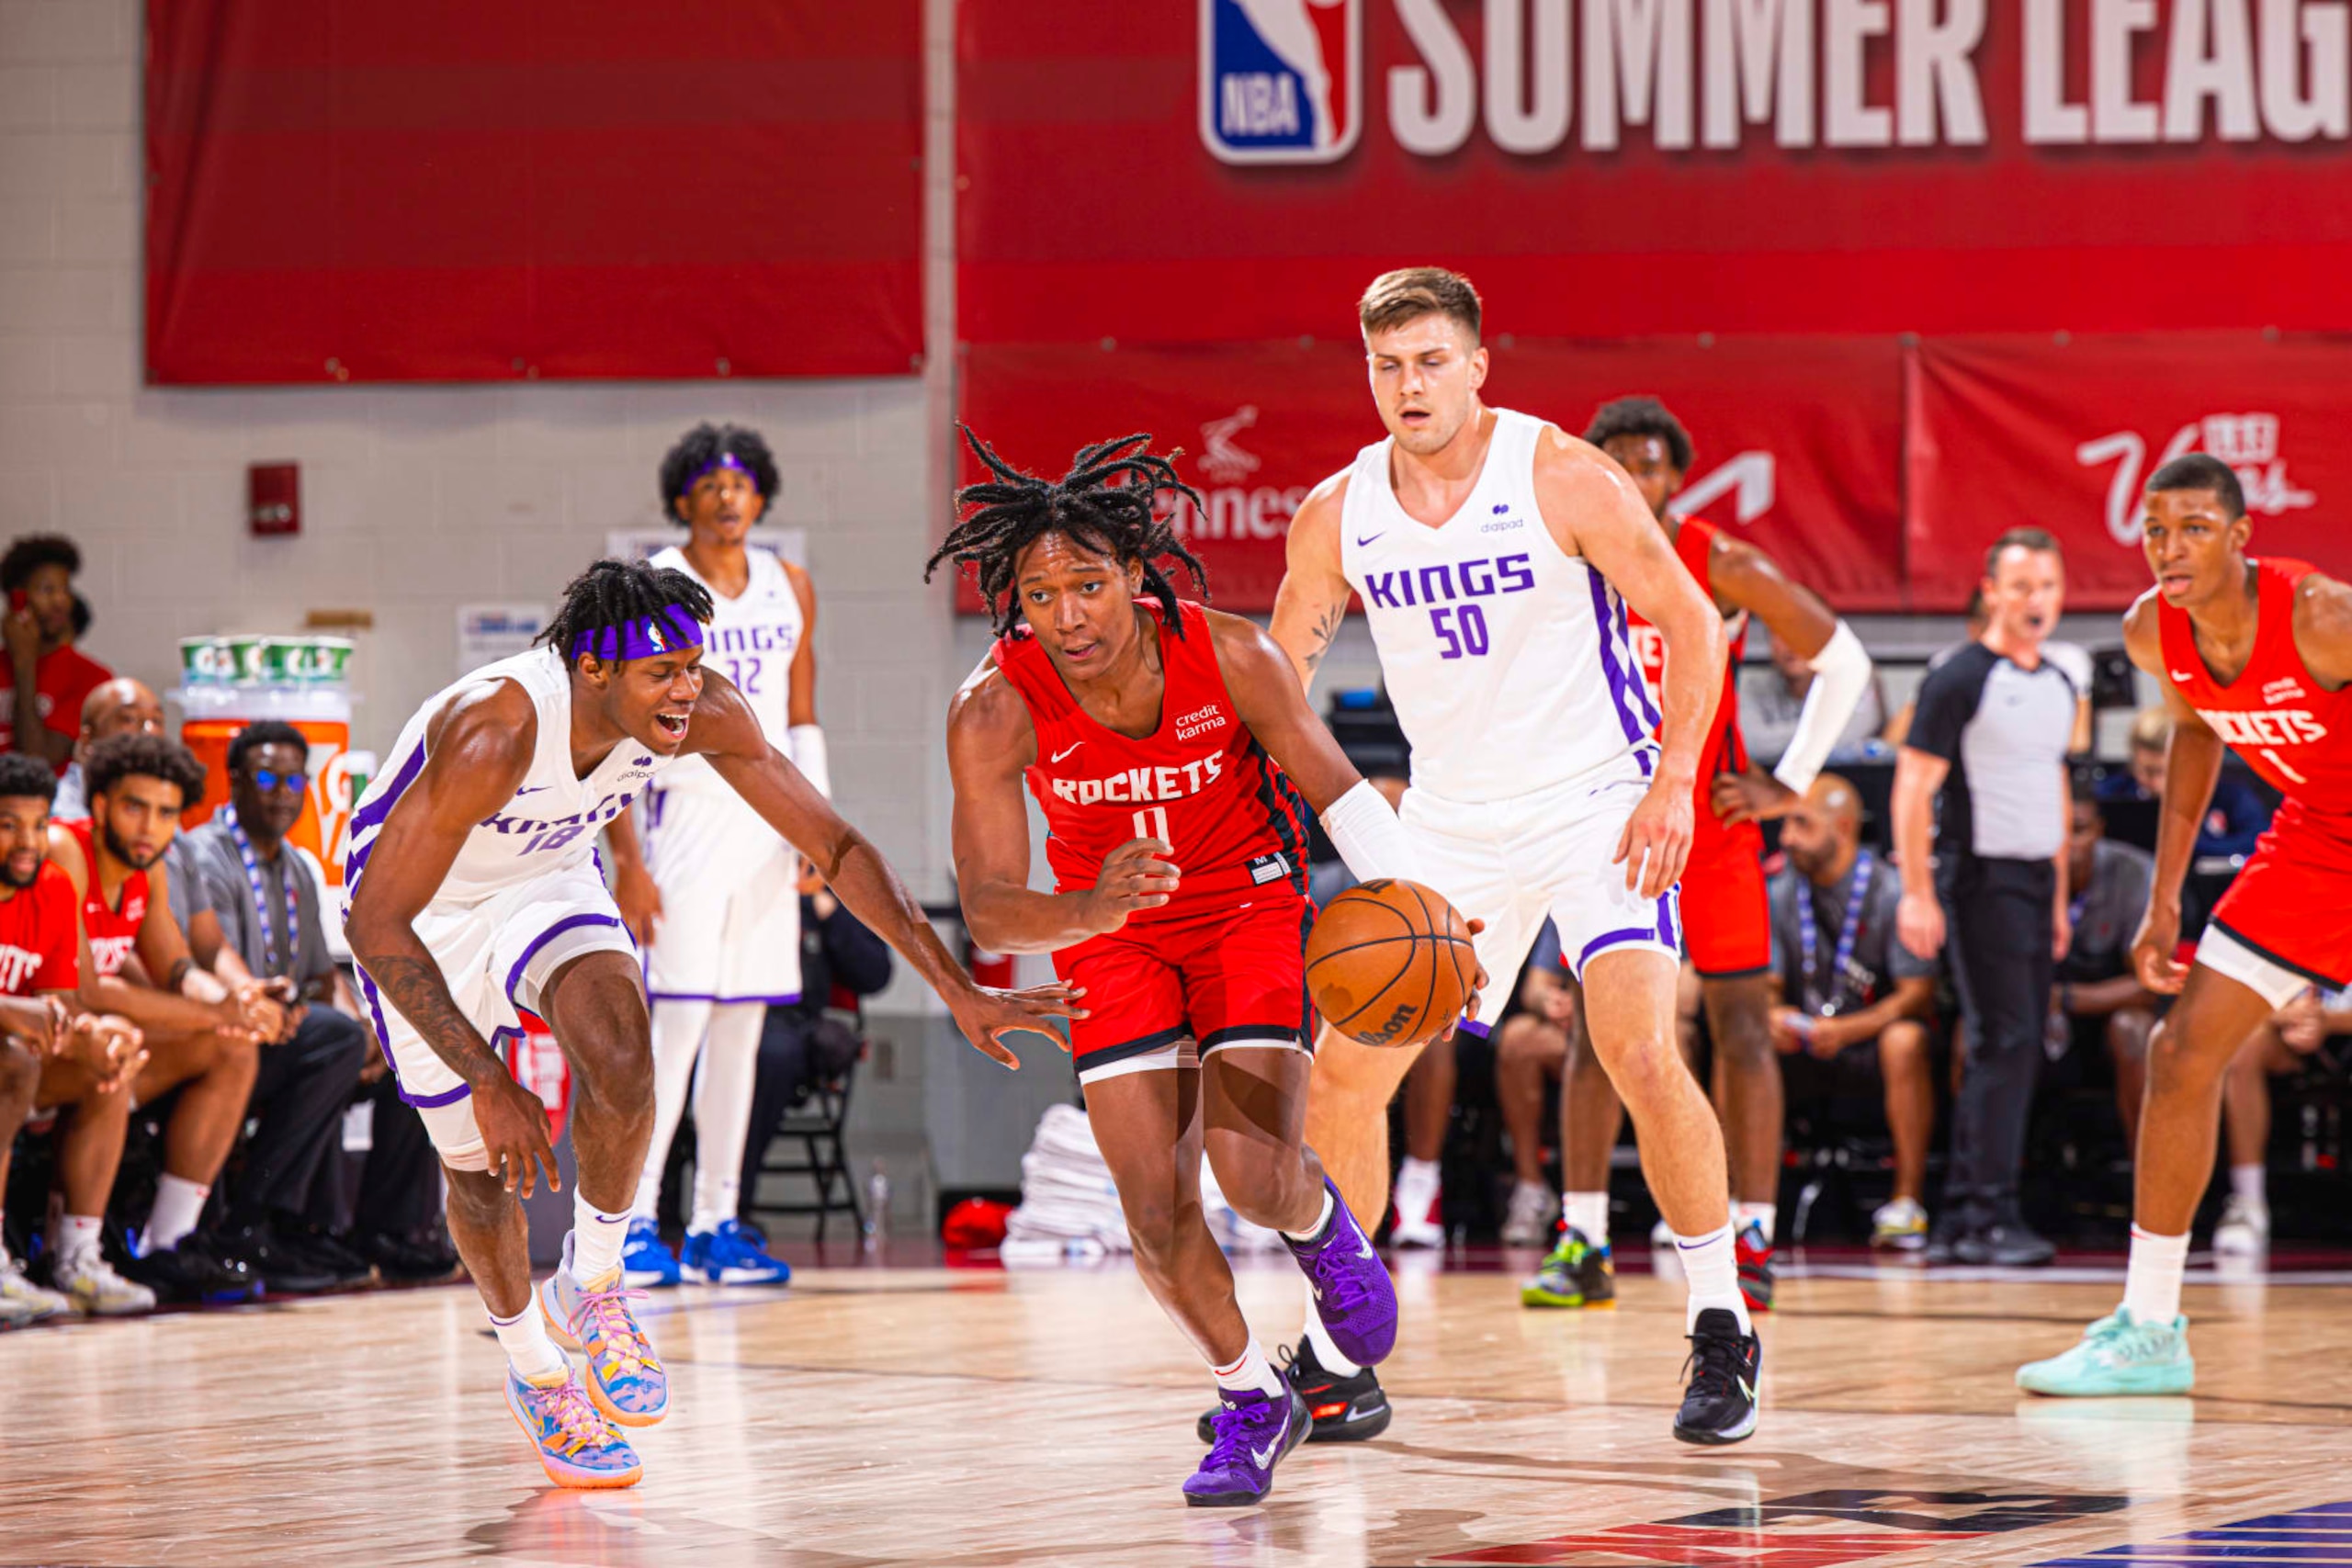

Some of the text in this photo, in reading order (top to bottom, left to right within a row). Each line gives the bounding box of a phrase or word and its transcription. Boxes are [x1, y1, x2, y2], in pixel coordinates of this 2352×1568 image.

[1386, 0, 1988, 155] SUMMER
[1221, 72, 1300, 137] NBA
[1480, 518, 1524, 533] dialpad
[1364, 552, 1535, 609] KINGS
[708, 626, 793, 653] INGS
[1429, 604, 1489, 660] 50
[1175, 705, 1220, 728] credit
[1175, 715, 1227, 741] karma
[1052, 750, 1224, 806] ROCKETS
[516, 825, 585, 857] 18
